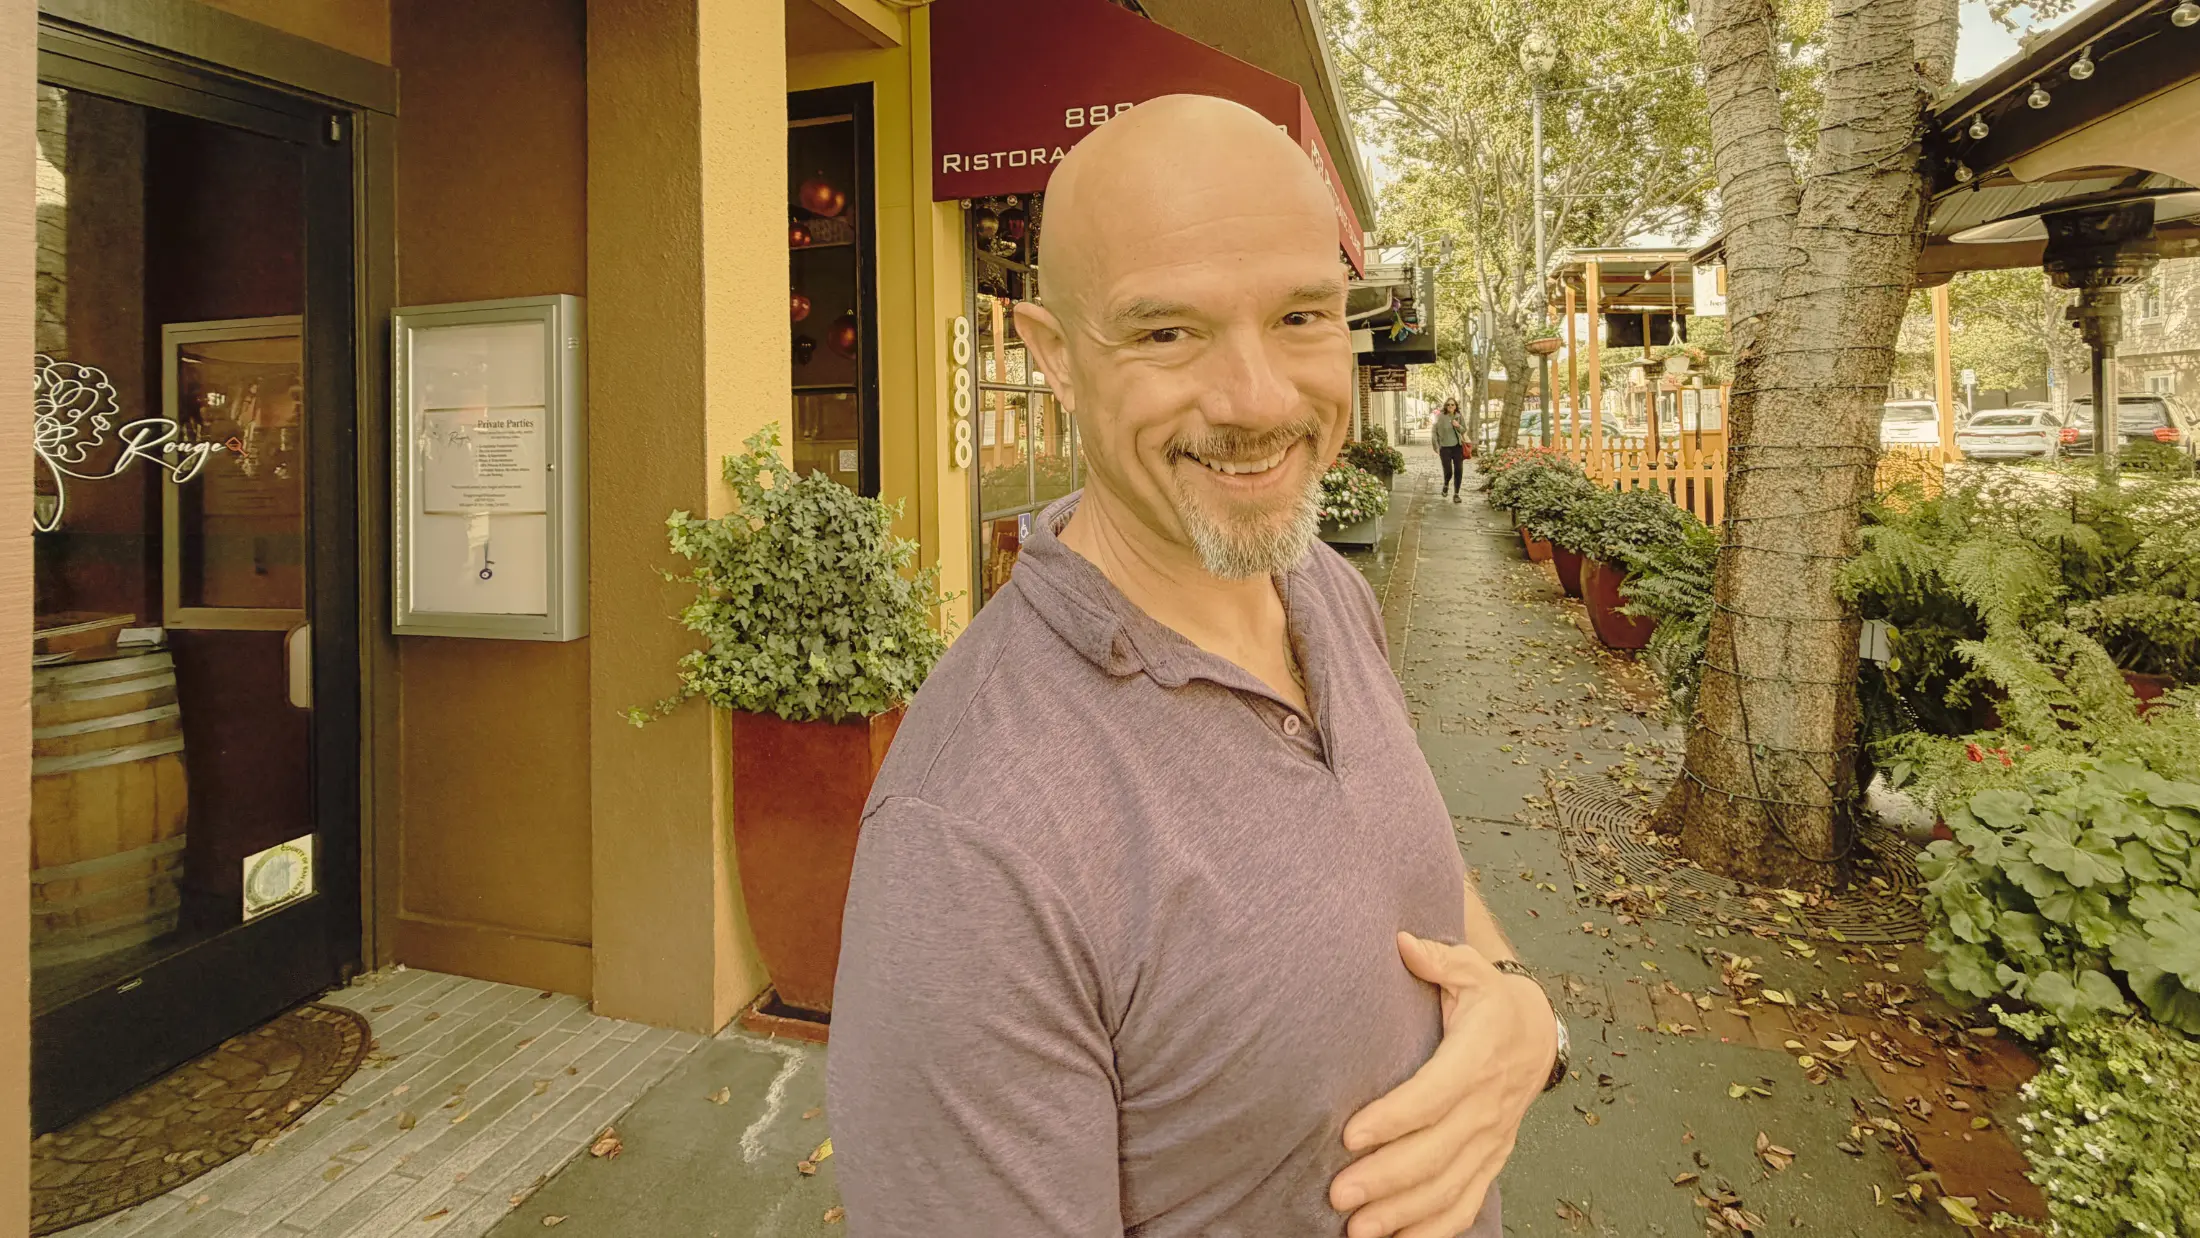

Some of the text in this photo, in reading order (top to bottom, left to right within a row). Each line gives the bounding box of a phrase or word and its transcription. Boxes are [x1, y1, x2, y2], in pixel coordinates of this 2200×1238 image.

[942, 145, 1076, 174] RISTORA
[953, 315, 973, 469] 888
[477, 418, 534, 429] Private Parties
[113, 418, 226, 483] Rouge
